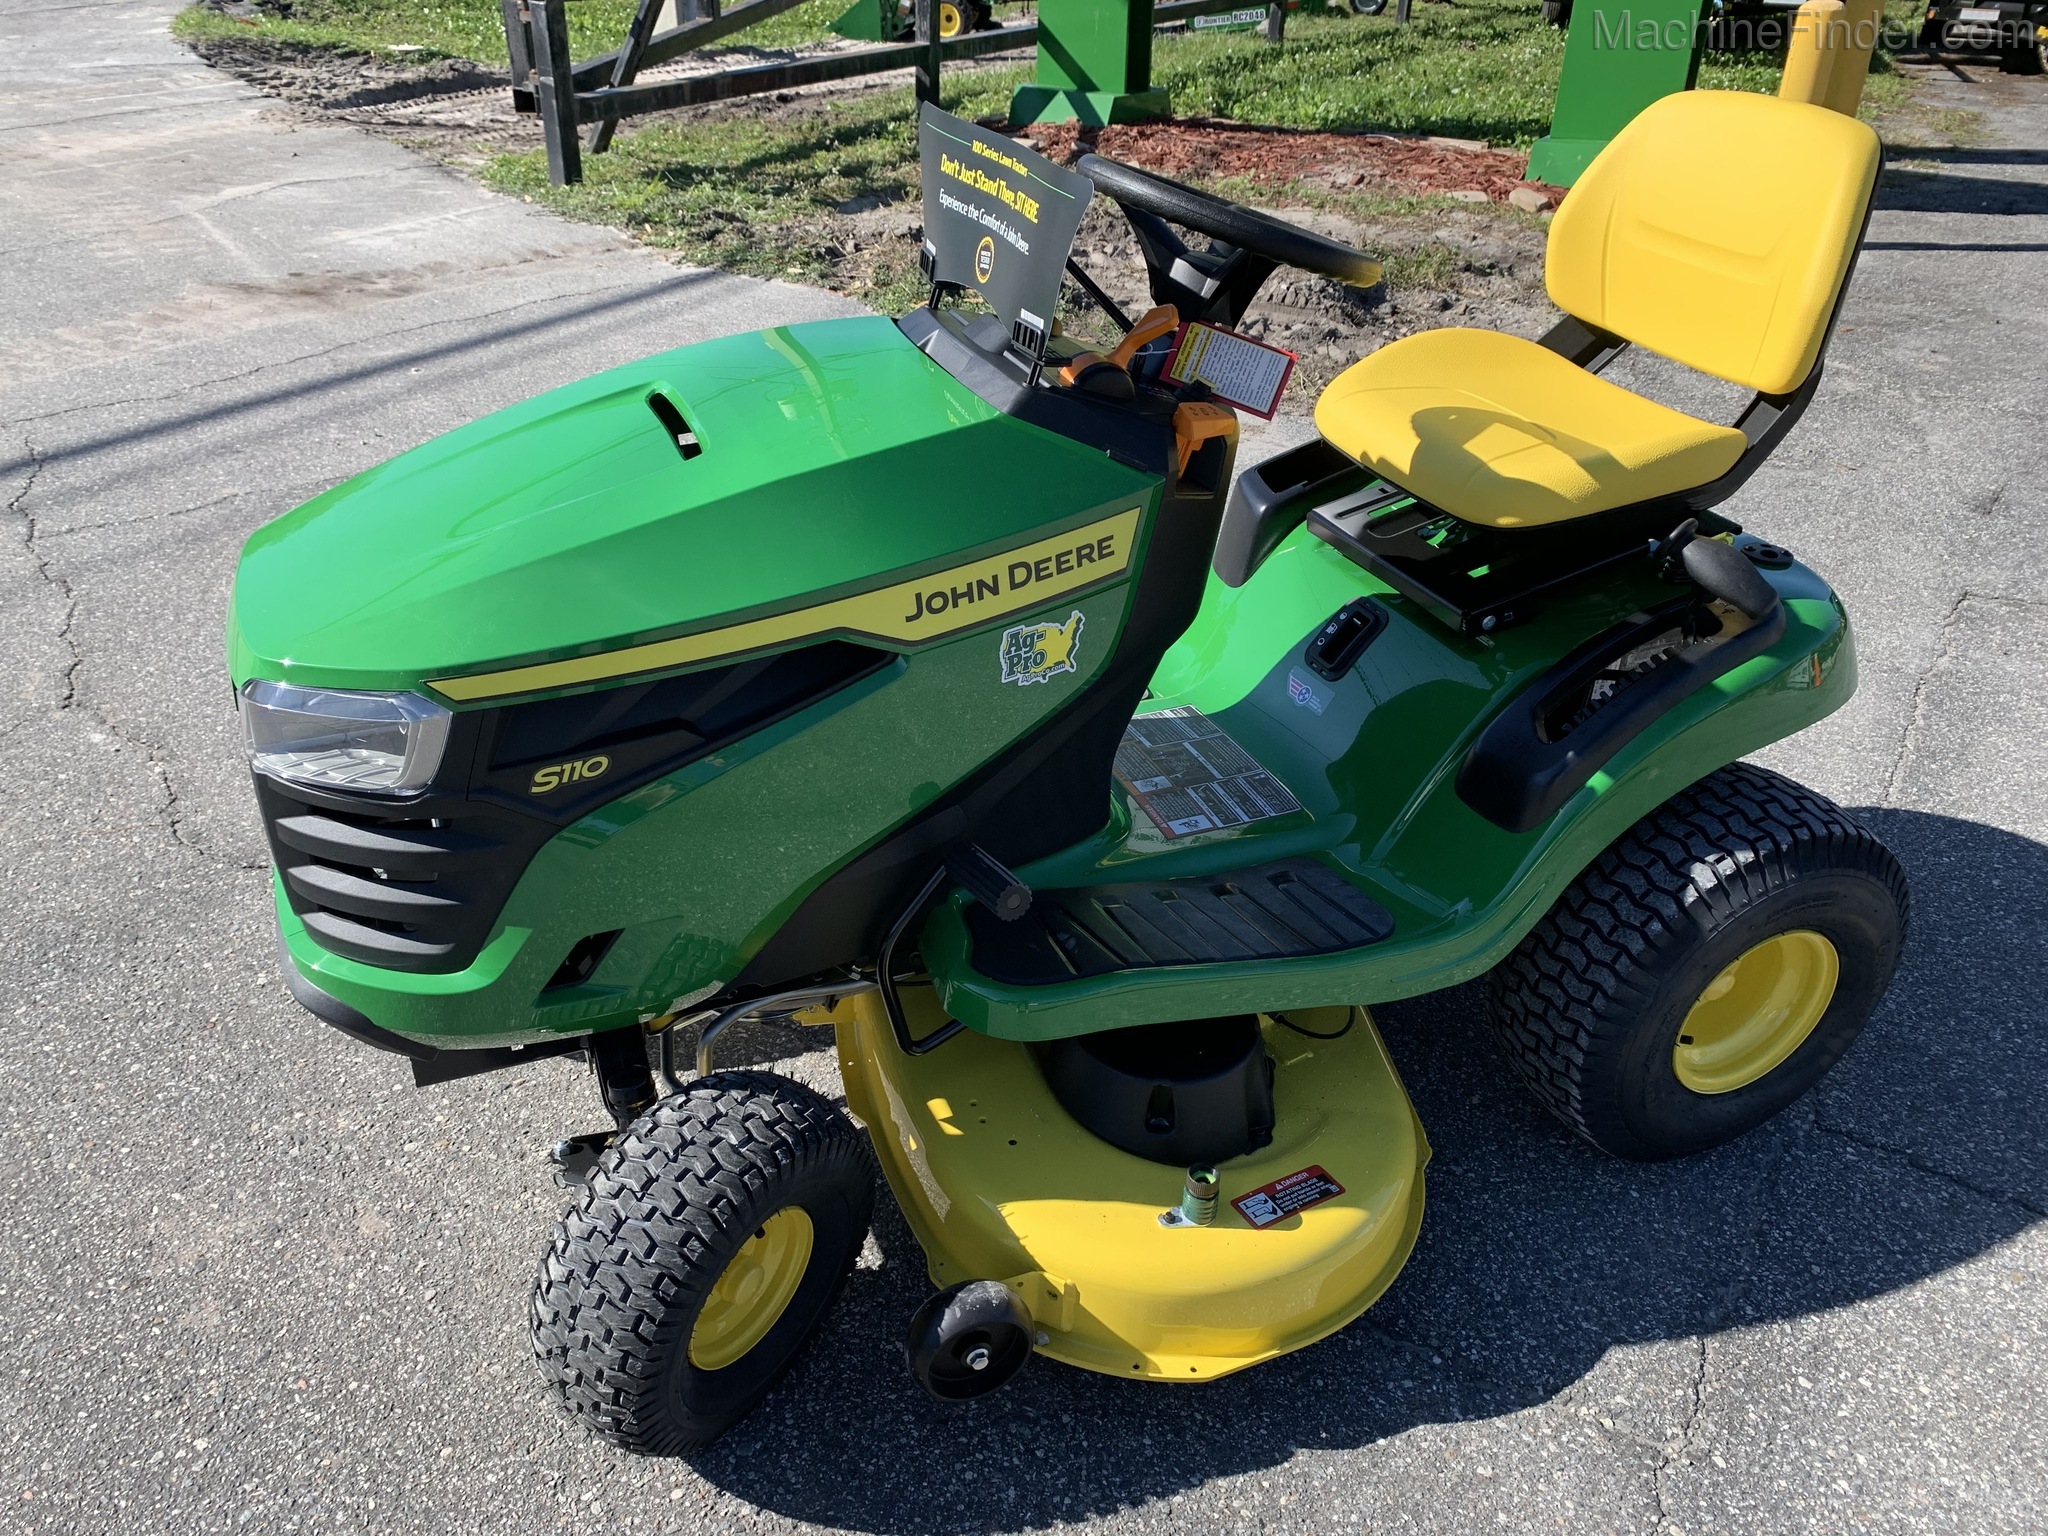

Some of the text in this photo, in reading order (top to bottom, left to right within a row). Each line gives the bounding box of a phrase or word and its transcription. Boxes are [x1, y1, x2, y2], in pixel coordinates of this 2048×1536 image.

[1233, 9, 1265, 21] RC2048
[972, 140, 1029, 177] 100 Series Lawn Tractors
[941, 153, 1040, 224] Don't Just Stand There, SIT HERE.
[939, 188, 968, 216] Experience
[968, 203, 979, 221] the
[979, 208, 1001, 234] Comfort
[1000, 221, 1007, 236] of
[1007, 226, 1017, 247] John
[1016, 232, 1030, 255] Deere.
[905, 534, 1115, 622] JOHN DEERE
[1005, 629, 1046, 656] Ag-
[1005, 650, 1047, 679] Pro
[1021, 663, 1066, 683] AgProCo.com
[531, 756, 609, 793] S110
[1275, 1178, 1318, 1199] ROTATING BLADE
[1281, 1172, 1310, 1187] DANGER
